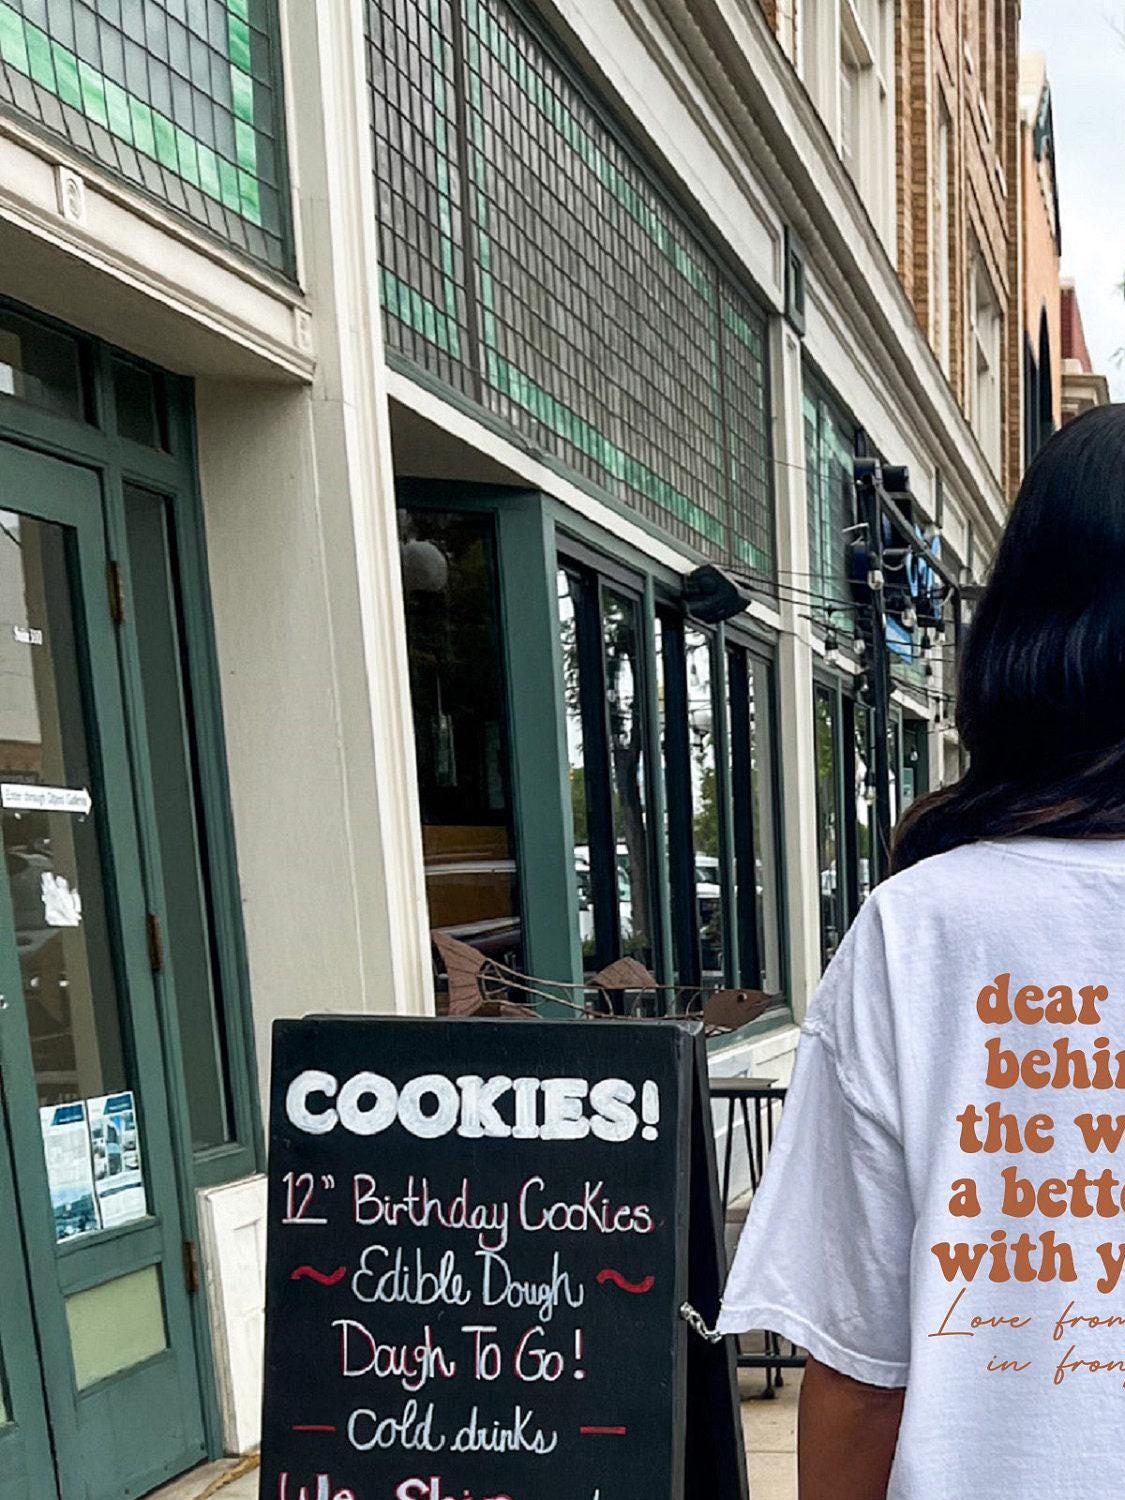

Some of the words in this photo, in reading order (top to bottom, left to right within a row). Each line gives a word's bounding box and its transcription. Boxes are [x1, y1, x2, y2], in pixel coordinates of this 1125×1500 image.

[975, 972, 1108, 1025] dear
[285, 1069, 661, 1142] COOKIES!
[956, 1101, 1055, 1154] the
[353, 1173, 509, 1251] Birthday
[948, 1178, 982, 1218] a
[351, 1244, 471, 1306] Edible
[475, 1250, 585, 1322] Dough
[930, 1229, 1078, 1284] with
[927, 1287, 1032, 1338] Love
[331, 1319, 456, 1392] Dough
[461, 1325, 502, 1381] To
[986, 1354, 1032, 1373] in
[347, 1399, 446, 1452] Cold
